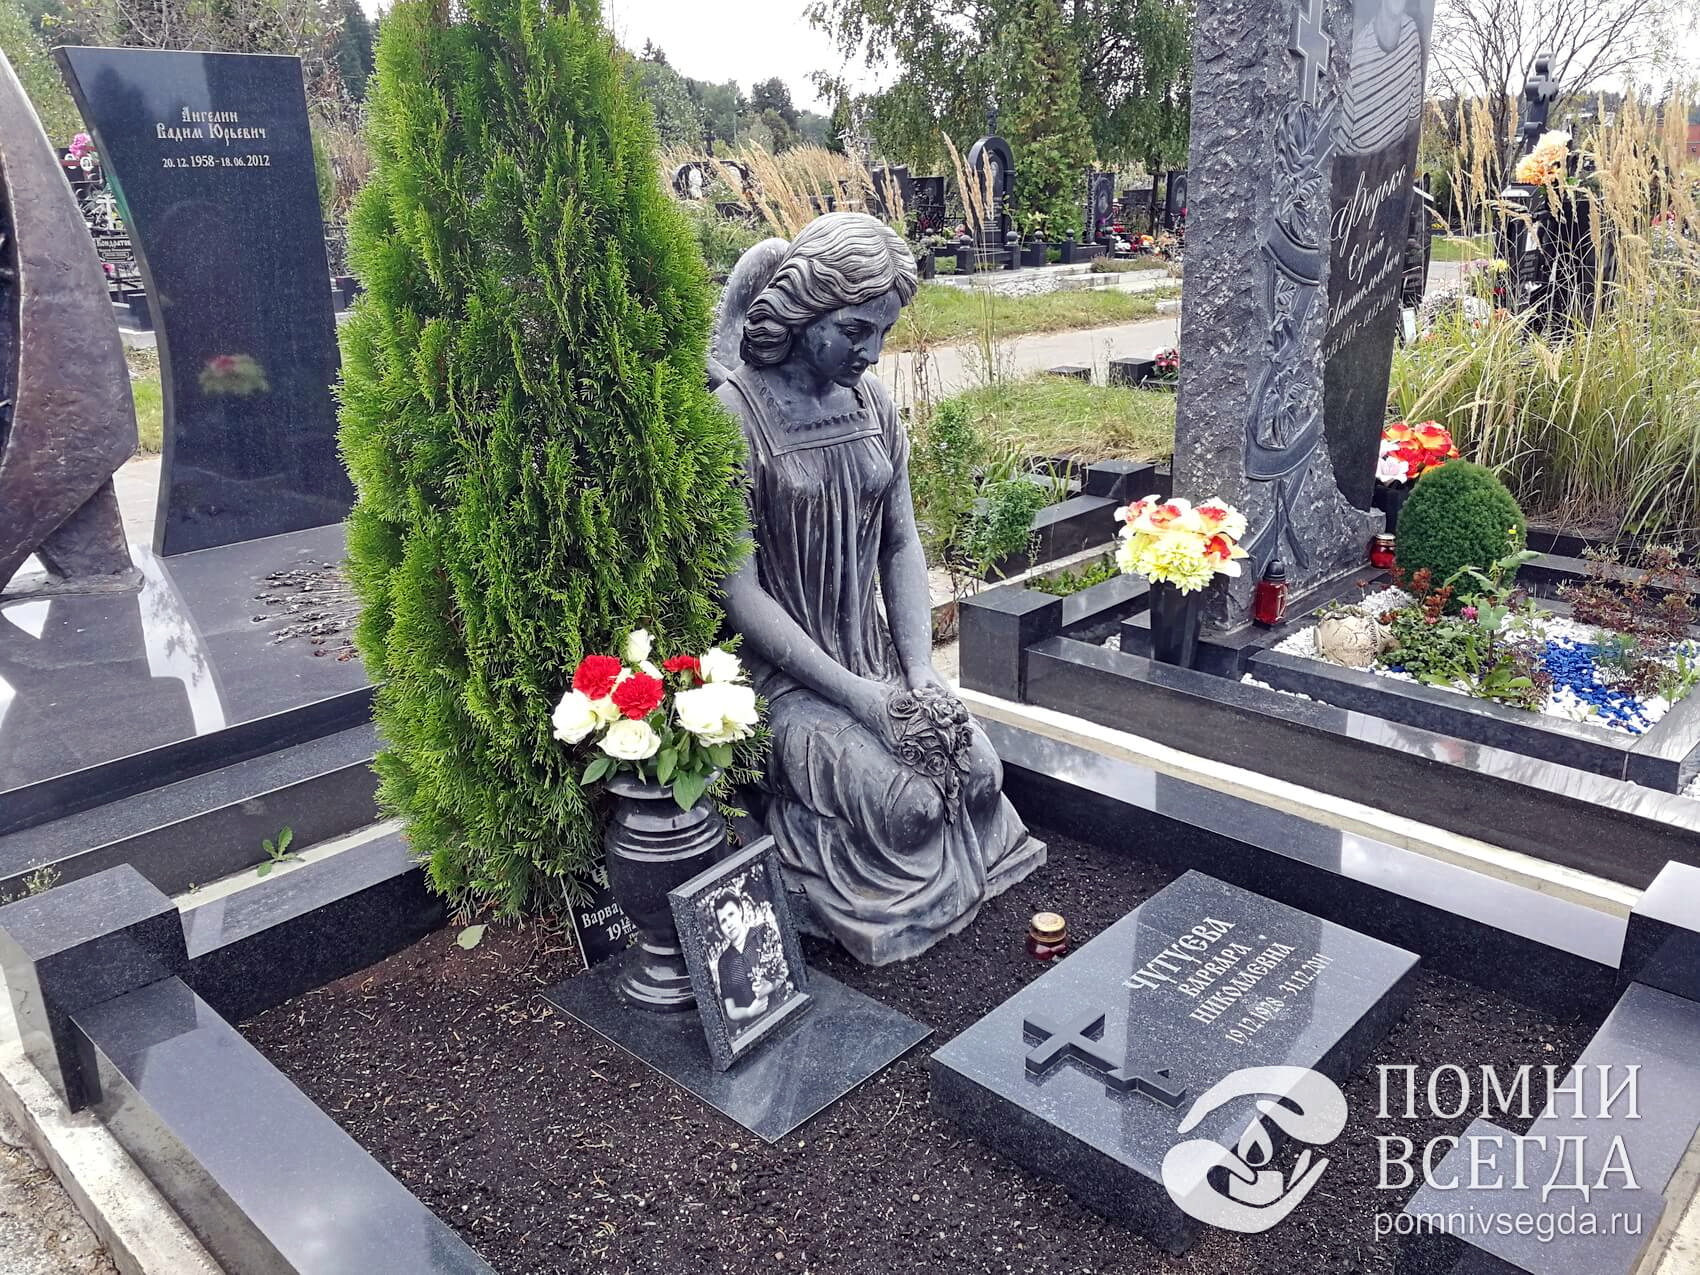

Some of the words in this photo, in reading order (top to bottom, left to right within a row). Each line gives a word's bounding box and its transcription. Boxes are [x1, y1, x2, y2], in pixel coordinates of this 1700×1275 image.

[156, 122, 203, 142] Вадим
[208, 123, 267, 146] Юрьевич
[182, 106, 238, 122] Ангелин
[1177, 942, 1252, 998] ВАРВАРА
[1189, 942, 1296, 1025] НИКОЛАЕВНА
[1225, 997, 1285, 1044] 19.12.1928
[1279, 953, 1334, 996] 31.12.2011
